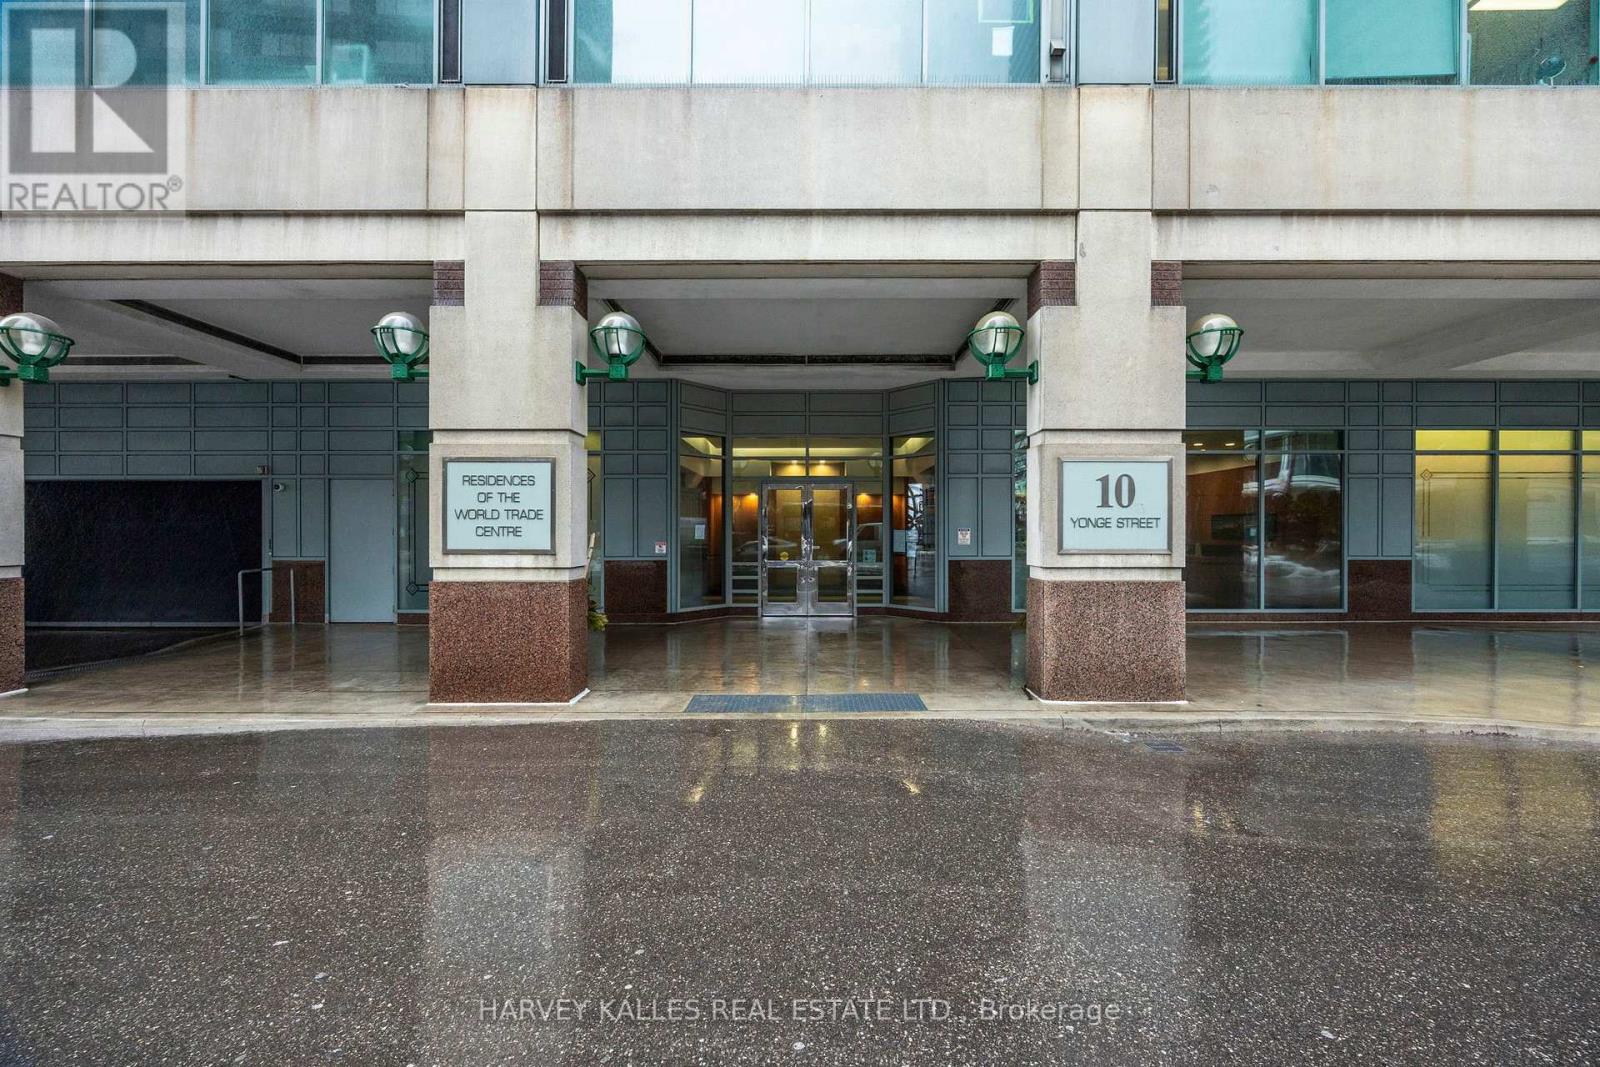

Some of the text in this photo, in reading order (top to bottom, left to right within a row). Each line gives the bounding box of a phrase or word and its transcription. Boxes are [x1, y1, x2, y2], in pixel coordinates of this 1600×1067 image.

[462, 475, 536, 487] RESIDENCES
[477, 491, 521, 503] OF THE
[1095, 473, 1136, 509] 10
[454, 508, 544, 520] WORLD TRADE
[1070, 517, 1161, 529] YONGE STREET
[475, 525, 522, 537] CENTRE
